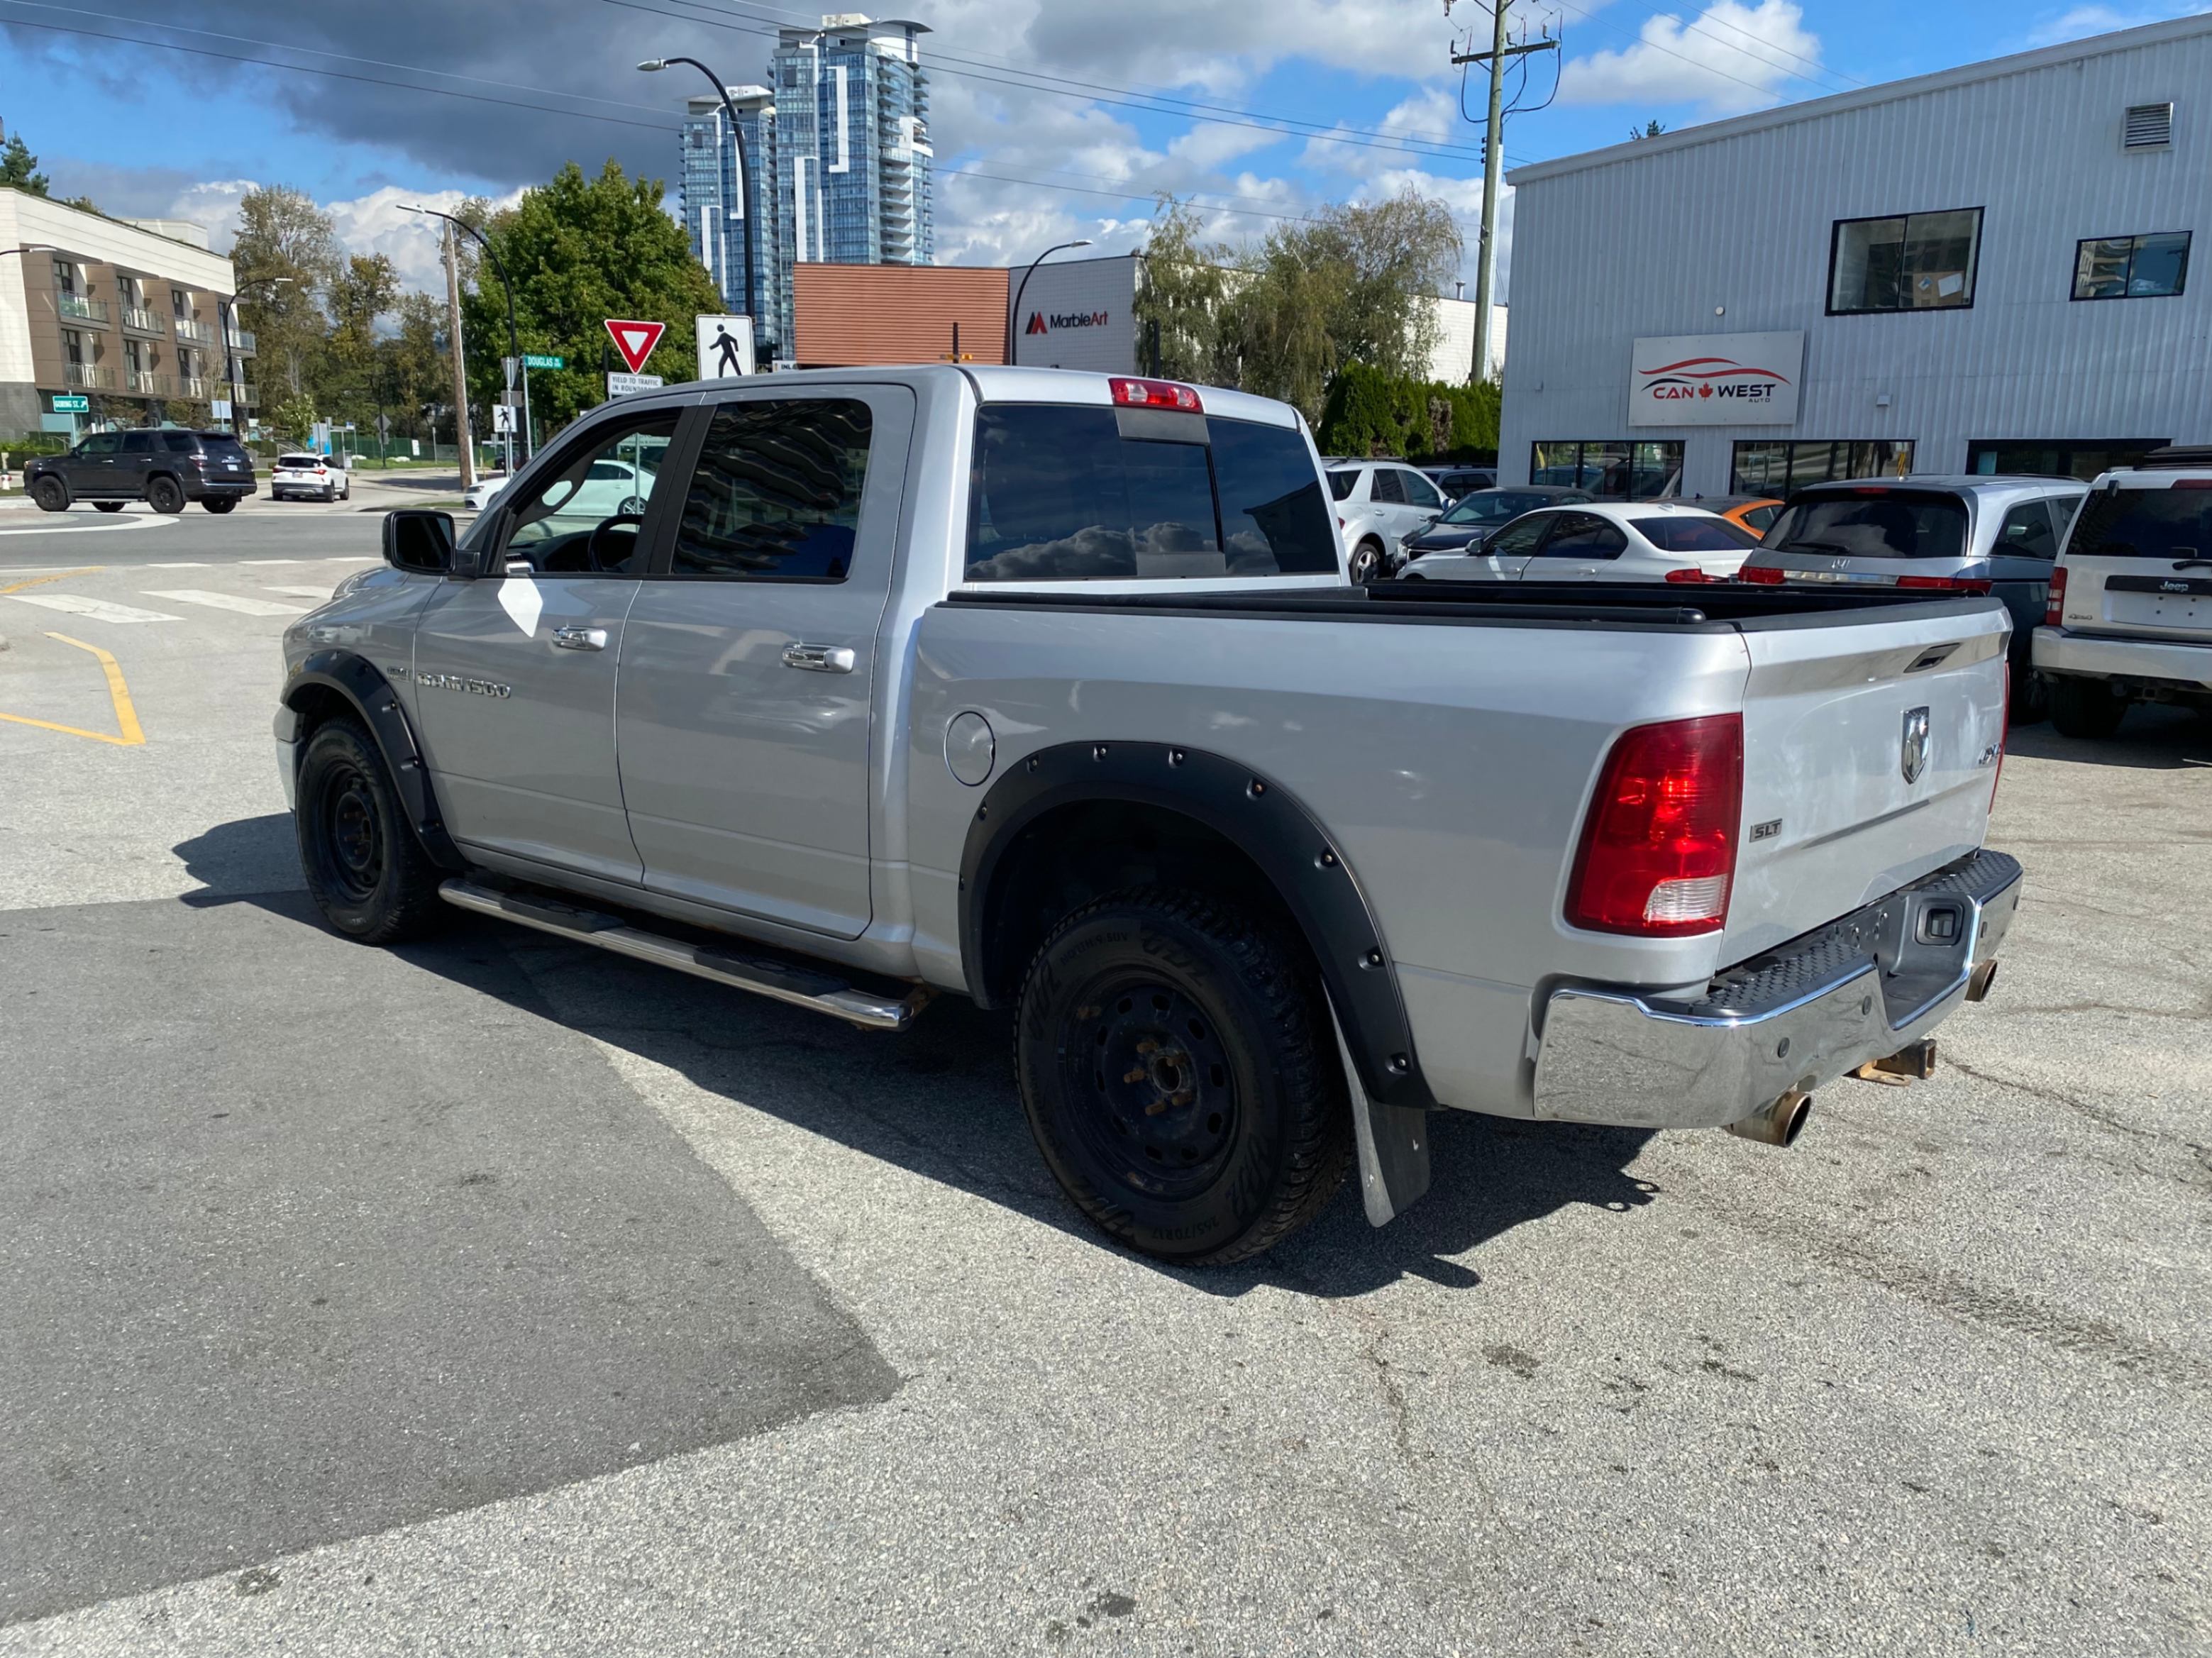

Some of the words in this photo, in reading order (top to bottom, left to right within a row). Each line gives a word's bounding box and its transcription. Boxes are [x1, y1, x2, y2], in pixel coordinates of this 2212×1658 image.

[1050, 311, 1108, 328] MarbleArt
[528, 356, 553, 367] DOUGLAS
[638, 378, 658, 387] TRAFFIC
[1653, 386, 1695, 399] CAN
[1718, 384, 1776, 398] WEST
[2160, 581, 2189, 593] Jeep
[417, 672, 464, 692] RAM
[465, 678, 511, 699] 1500
[1754, 822, 1781, 839] SLT
